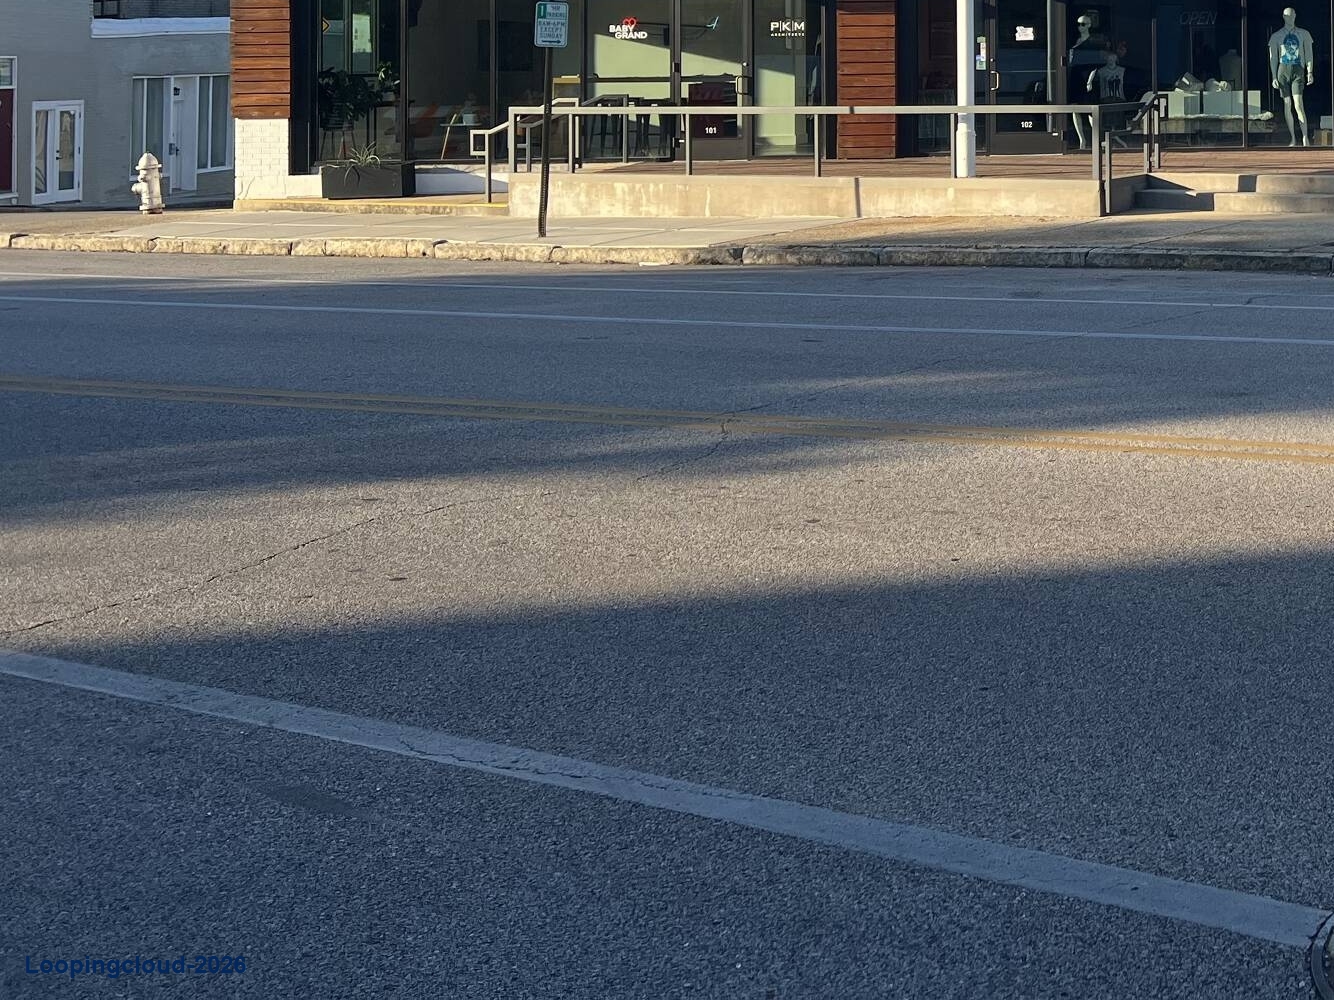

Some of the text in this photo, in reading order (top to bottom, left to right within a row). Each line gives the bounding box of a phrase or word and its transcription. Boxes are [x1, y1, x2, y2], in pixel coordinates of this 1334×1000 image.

[1179, 10, 1217, 25] OPEN
[609, 24, 635, 32] BABY
[615, 31, 647, 39] GRAND
[705, 126, 717, 134] 101
